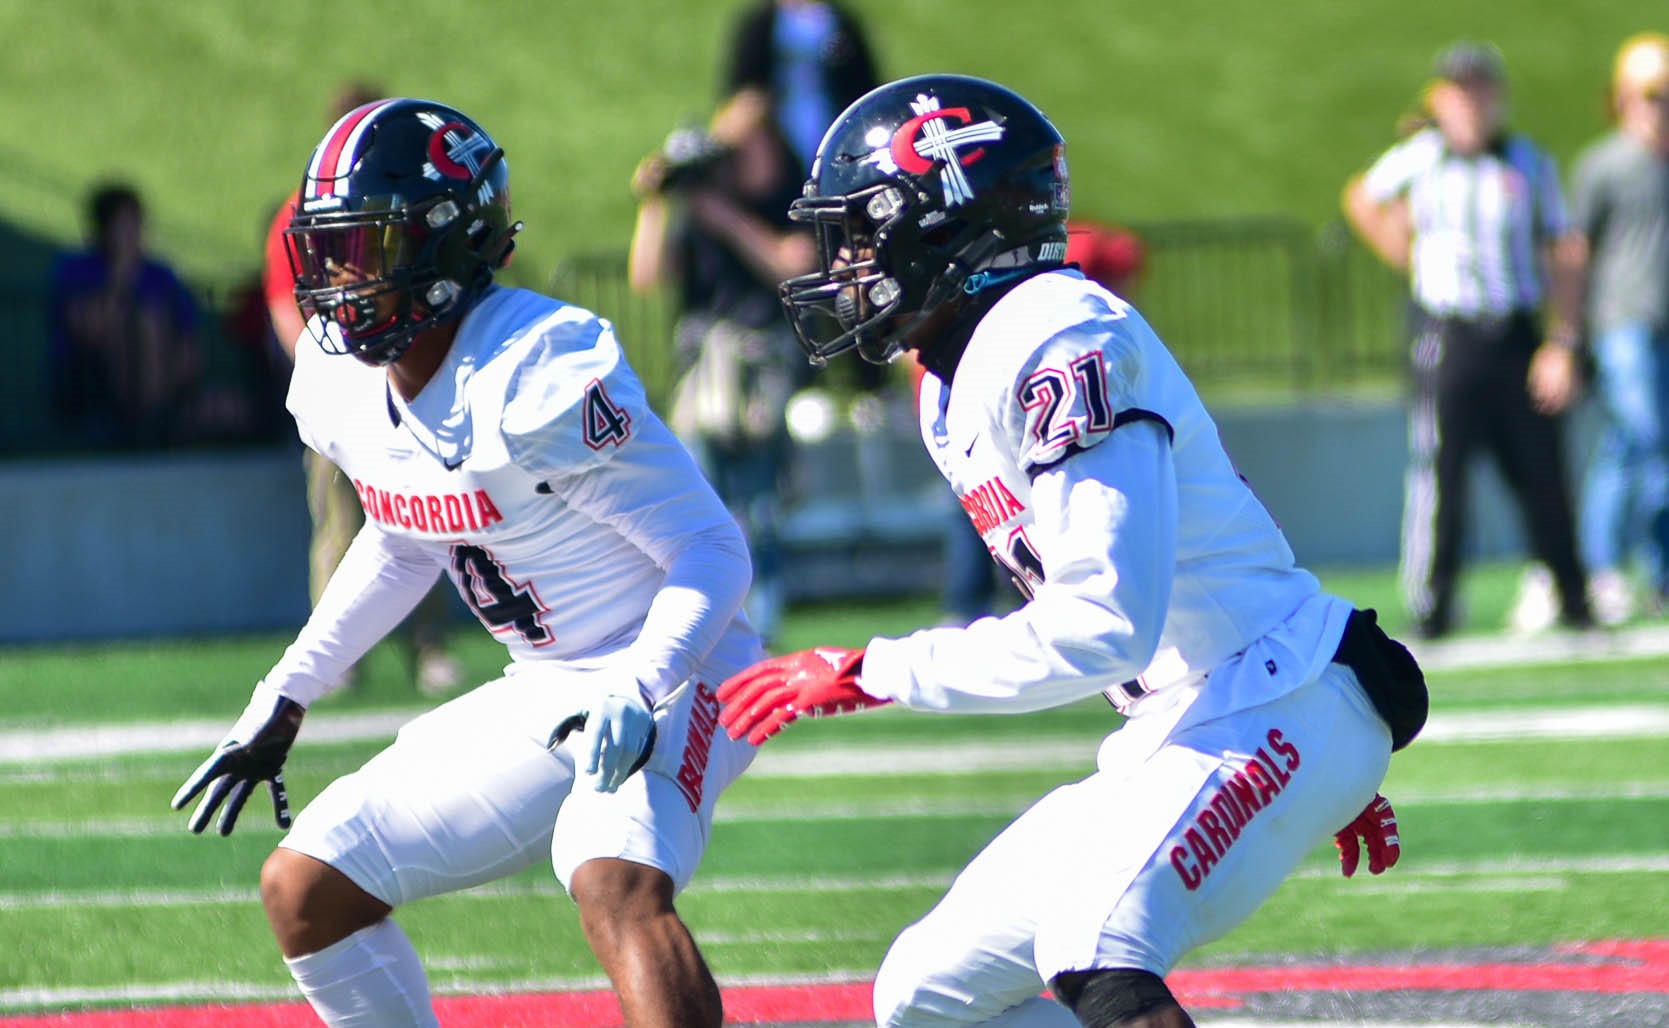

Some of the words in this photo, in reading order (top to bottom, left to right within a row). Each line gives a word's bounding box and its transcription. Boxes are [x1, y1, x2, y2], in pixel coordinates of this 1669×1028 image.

[583, 378, 632, 451] 4
[1017, 350, 1114, 456] 21
[354, 479, 505, 533] CONCORDIA
[448, 540, 557, 648] 4
[1169, 728, 1300, 891] CARDINALS
